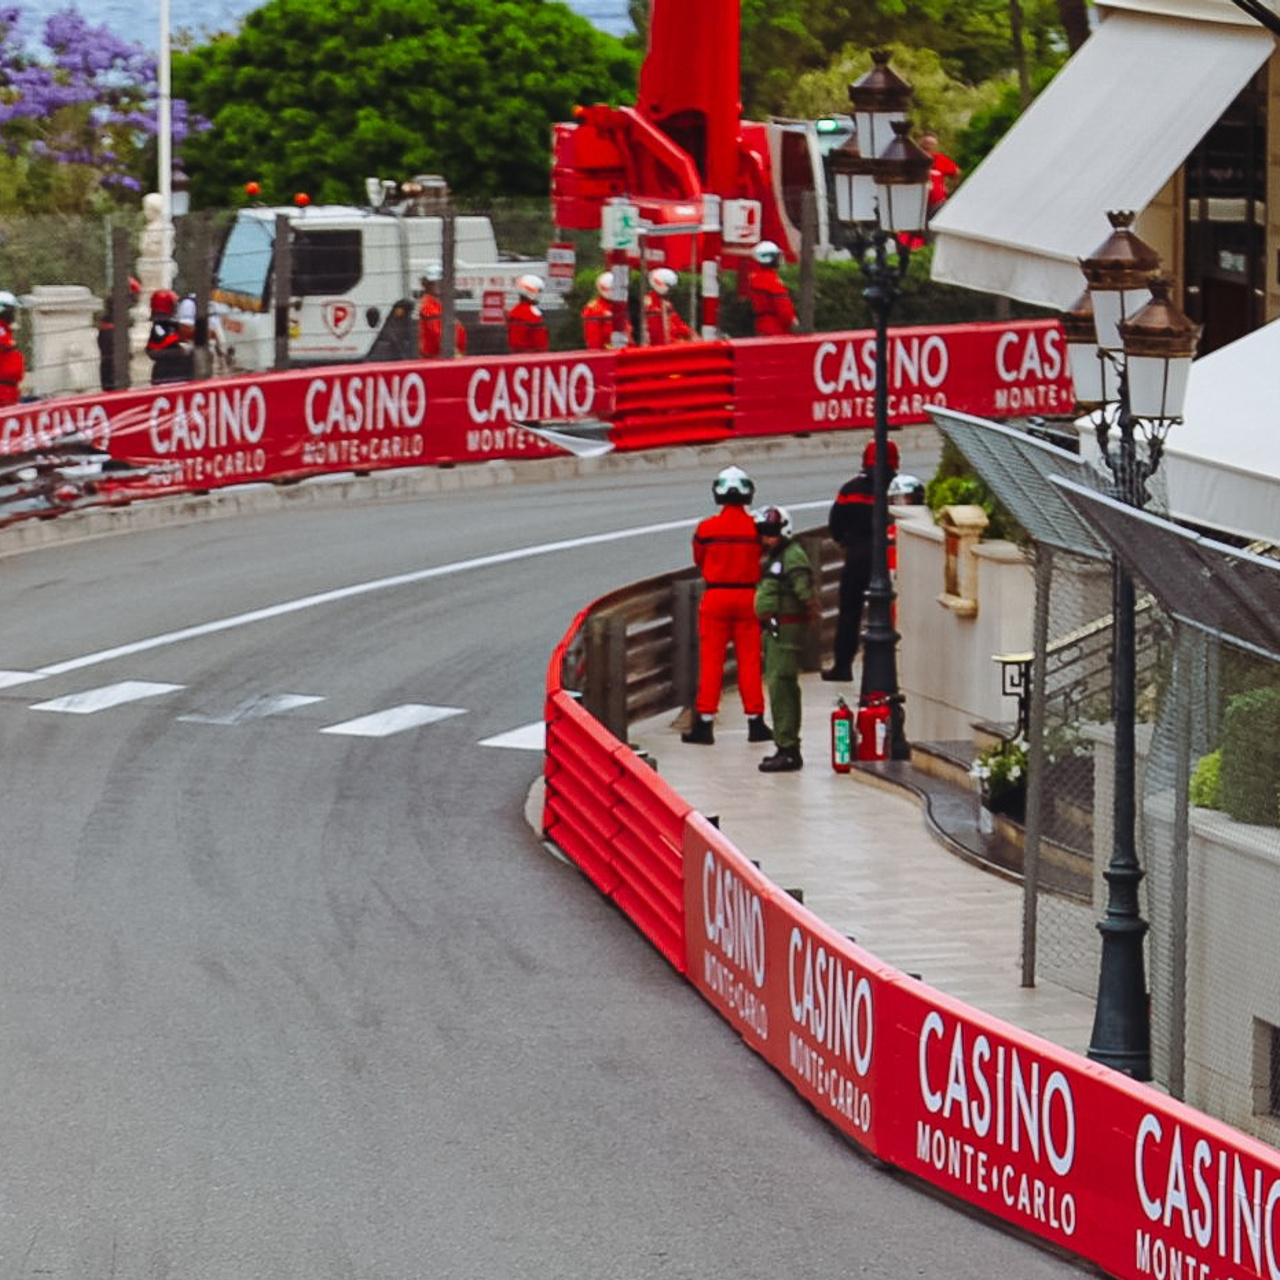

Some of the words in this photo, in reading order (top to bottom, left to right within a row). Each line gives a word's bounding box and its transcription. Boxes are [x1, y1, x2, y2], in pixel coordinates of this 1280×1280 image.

[467, 362, 595, 423] CASINO
[813, 335, 949, 394] CASNO
[149, 385, 266, 454] CASINO
[305, 372, 427, 435] CASINO
[812, 396, 875, 422] MONTE
[995, 385, 1058, 409] MONTE
[214, 449, 266, 479] CARLO
[369, 434, 424, 460] CARLO
[467, 428, 526, 453] MONTE
[703, 850, 766, 988] CASINO
[788, 927, 873, 1077] CASINO
[788, 1029, 825, 1094] MONTE
[828, 1064, 871, 1134] CARLO
[919, 1010, 1076, 1176] CASINO
[917, 1119, 989, 1193] MONTE
[1001, 1163, 1076, 1236] CARLO
